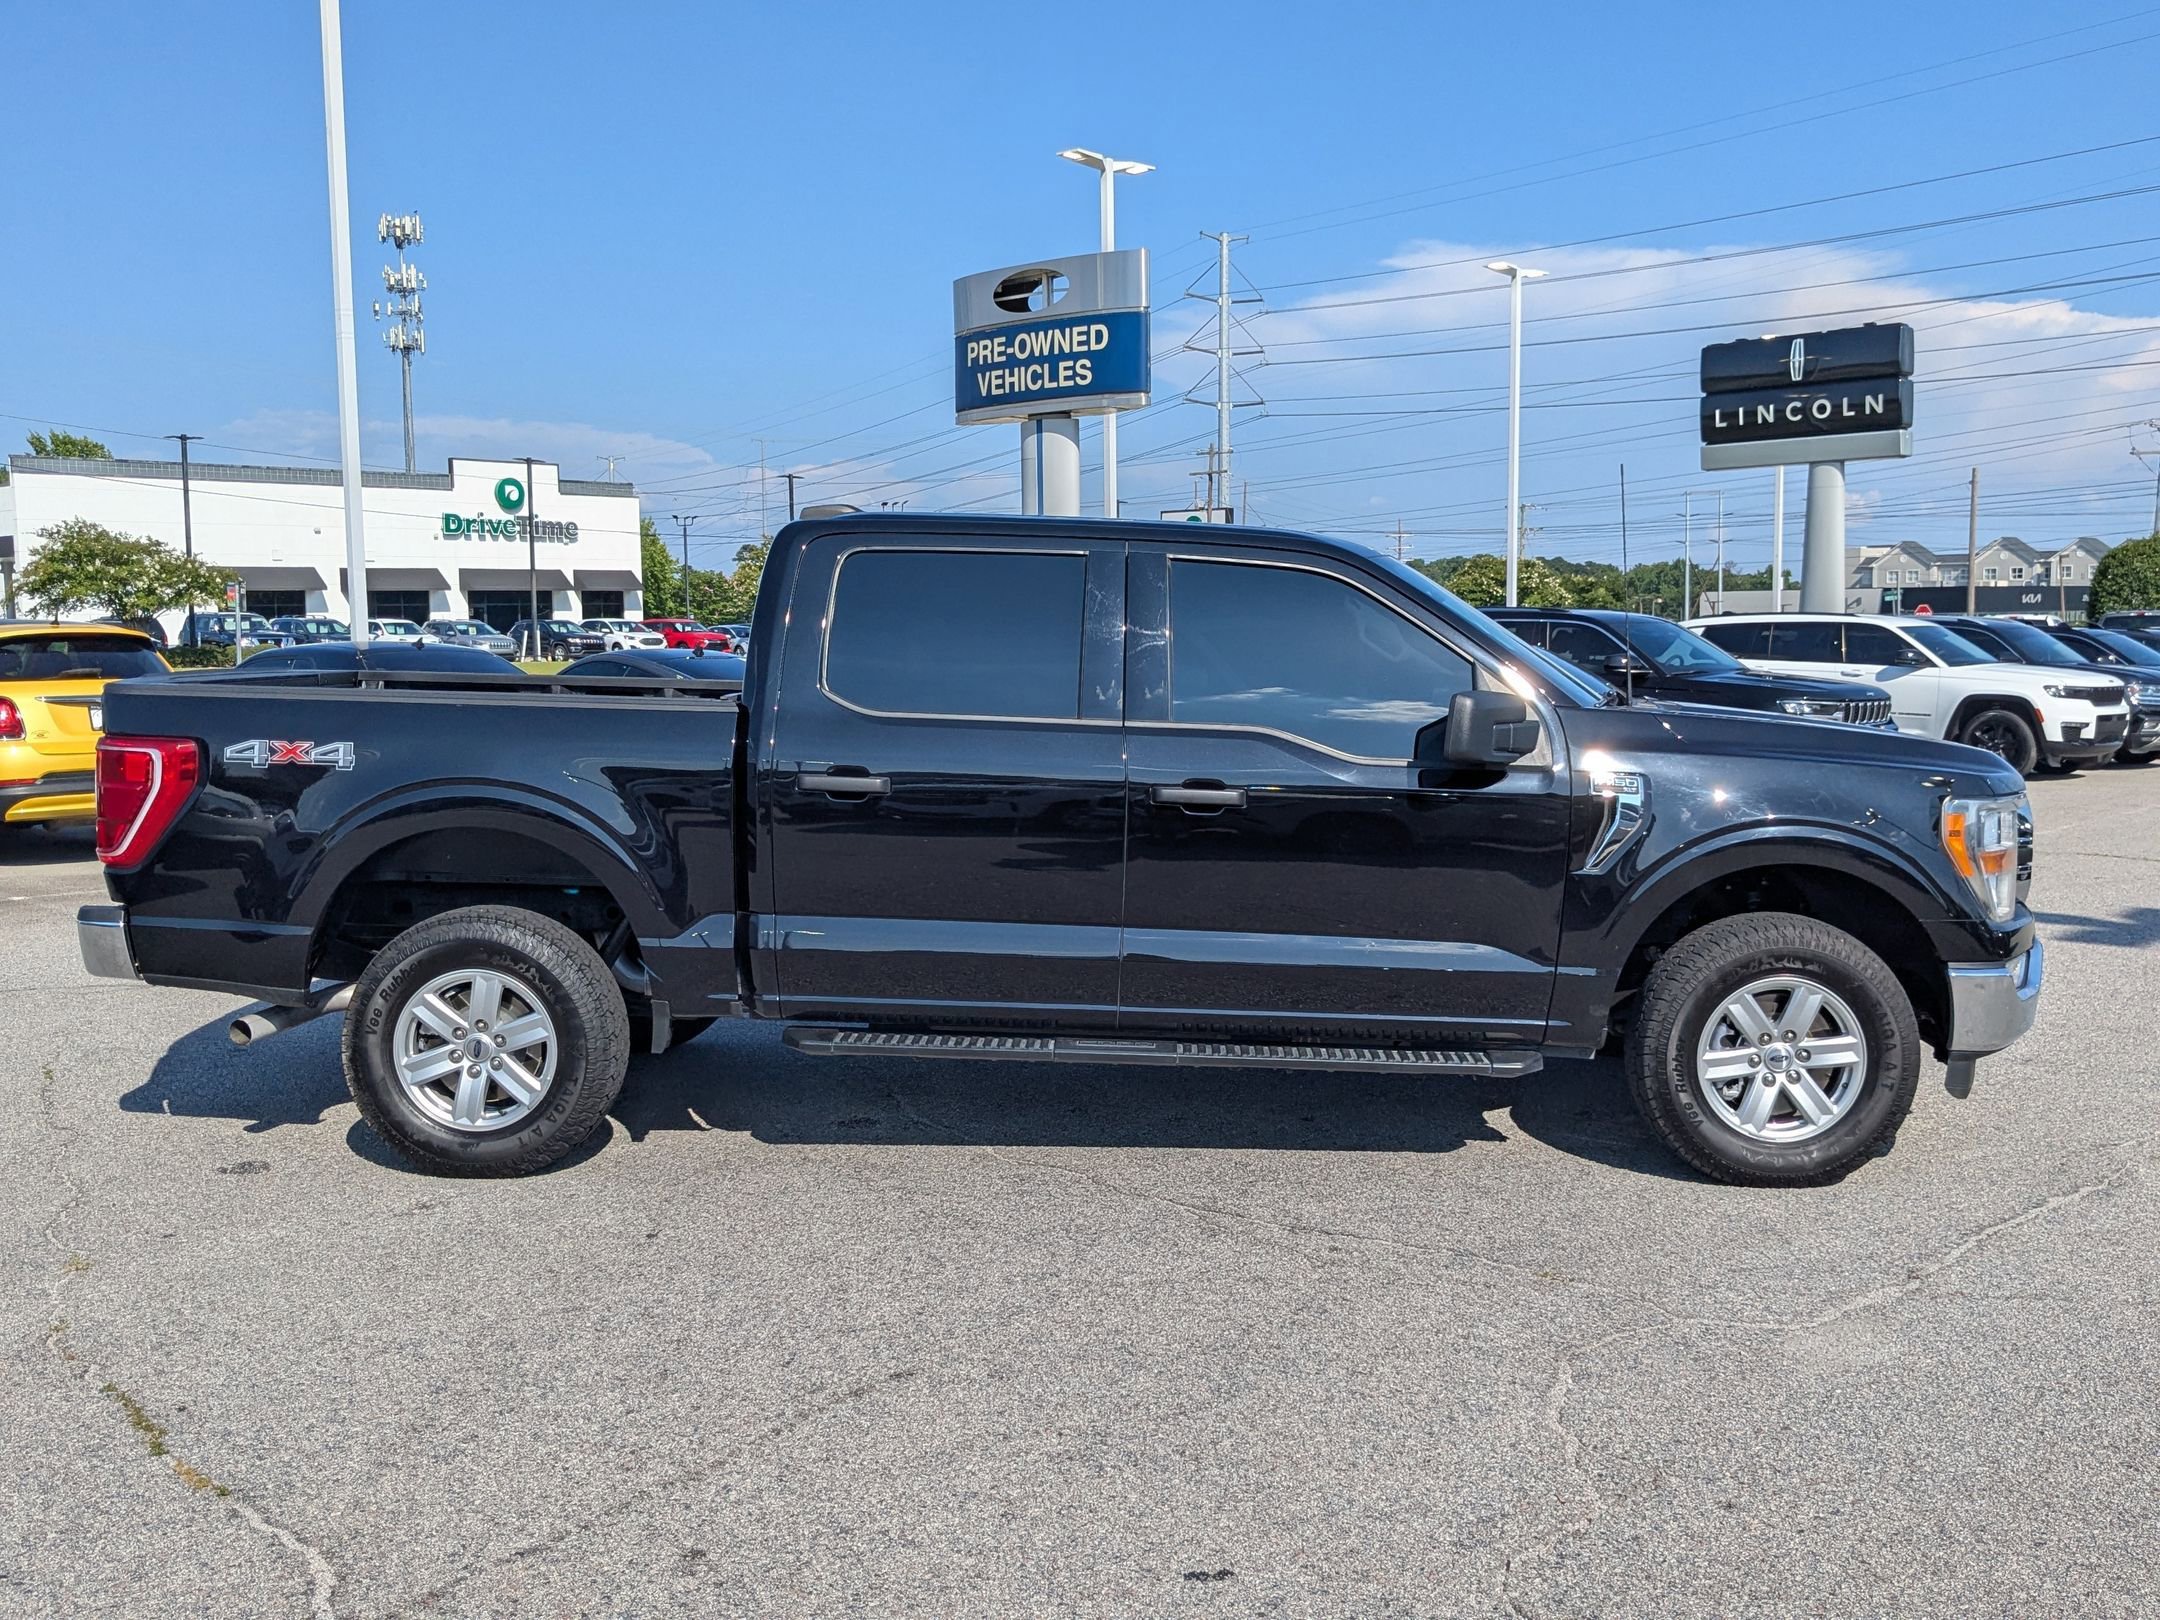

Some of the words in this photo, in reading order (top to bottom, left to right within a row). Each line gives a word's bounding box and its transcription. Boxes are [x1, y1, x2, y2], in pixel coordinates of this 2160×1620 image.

[967, 324, 1109, 368] PRE-OWNED
[977, 359, 1093, 397] VEHICLES
[1714, 394, 1884, 428] LINCOLN
[442, 512, 579, 540] DriveTime
[365, 1007, 383, 1035] Vee
[379, 960, 424, 1002] Rubber
[1881, 1061, 1897, 1092] A/T
[545, 1077, 578, 1123] TAIGA
[1684, 1102, 1704, 1126] Vee
